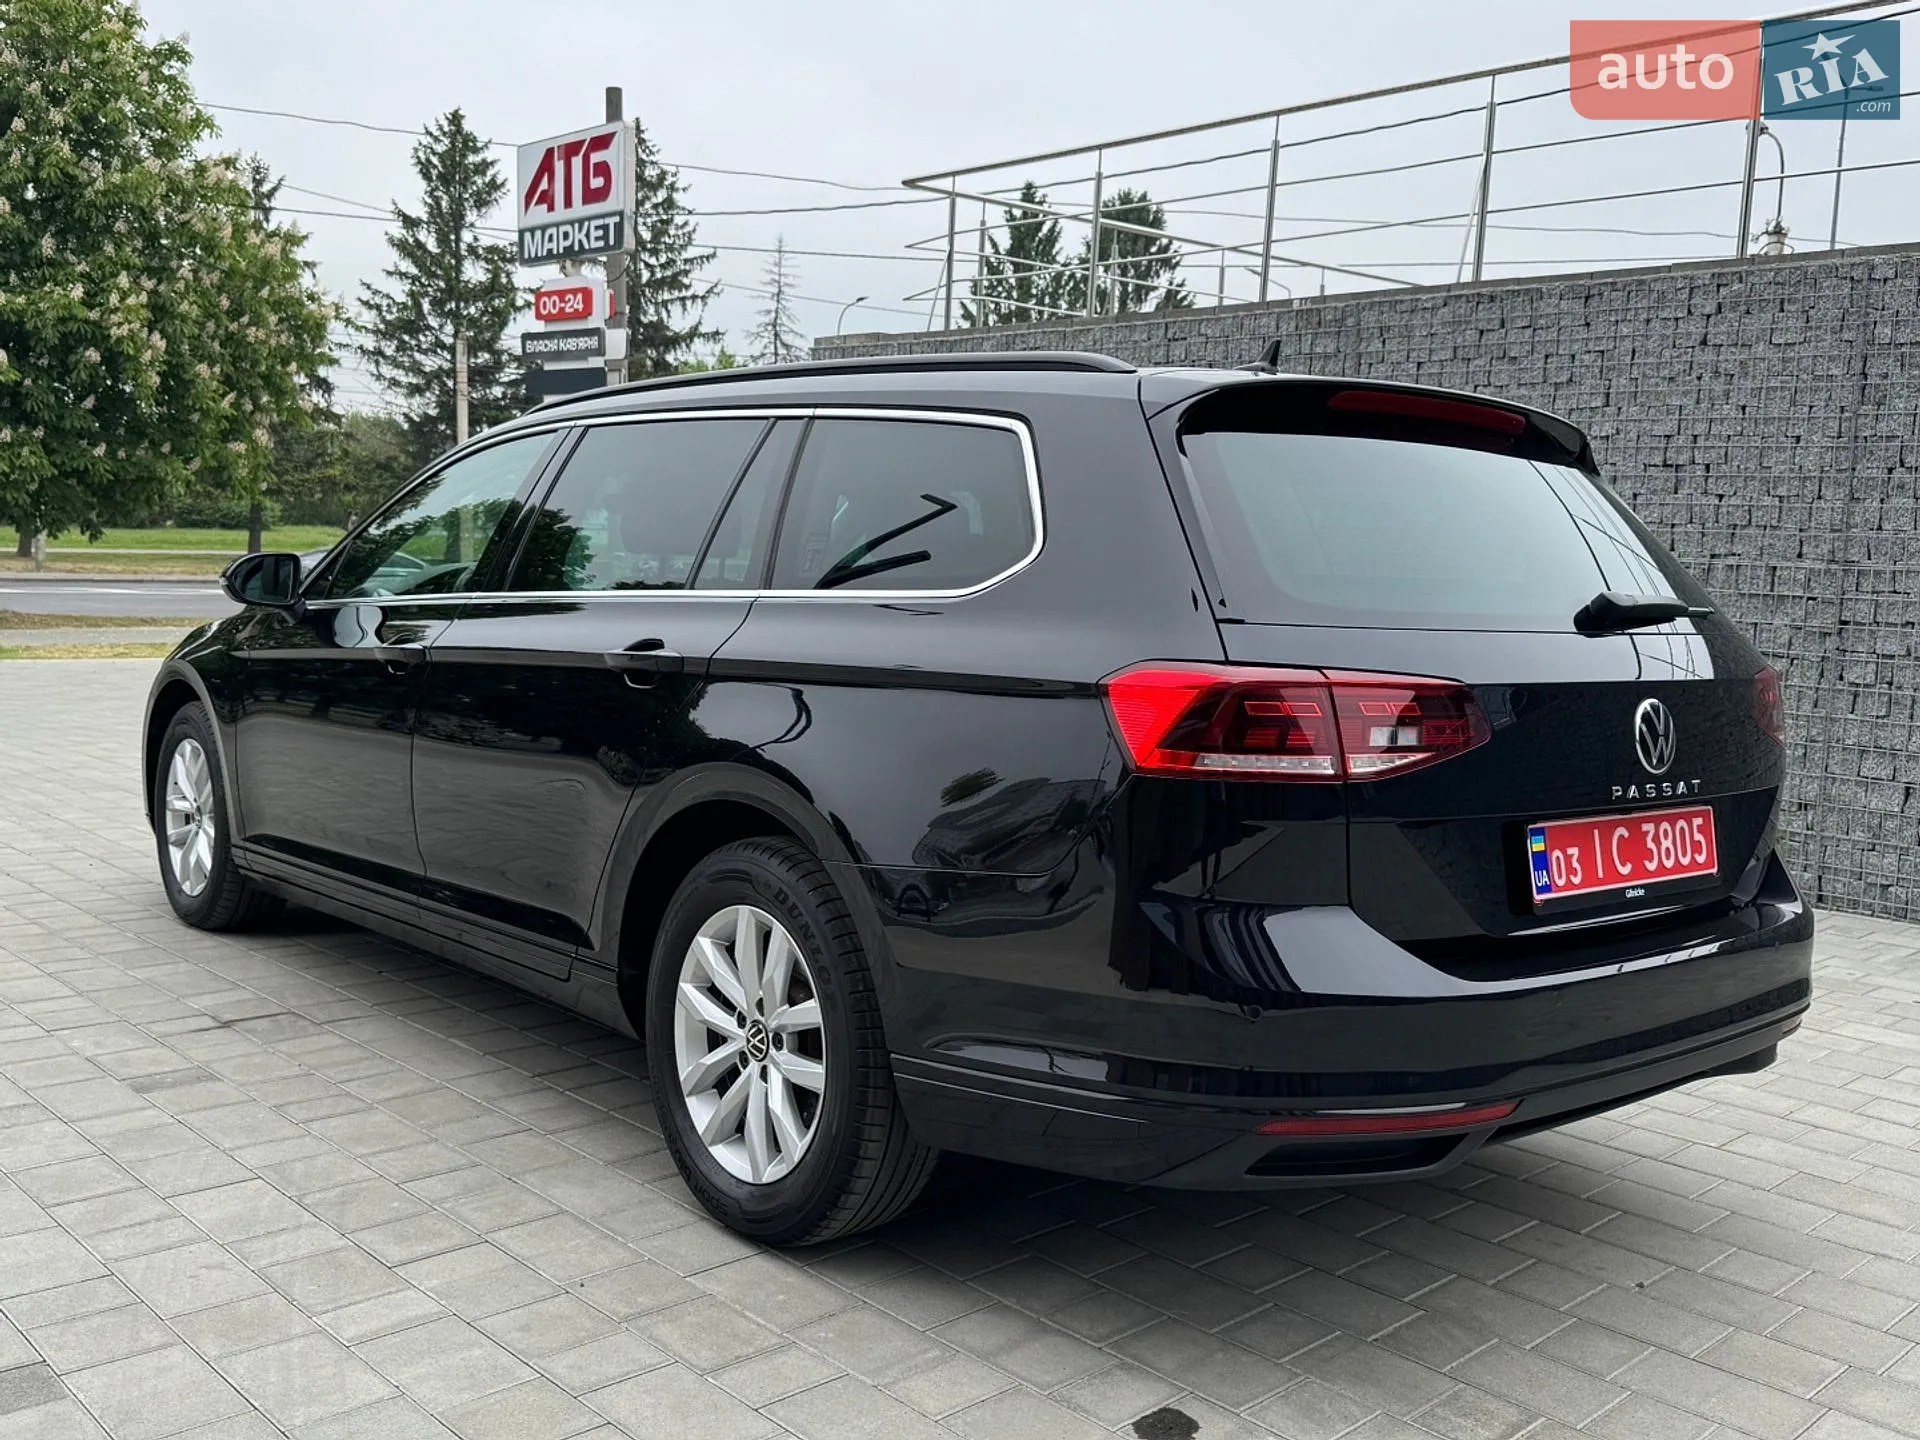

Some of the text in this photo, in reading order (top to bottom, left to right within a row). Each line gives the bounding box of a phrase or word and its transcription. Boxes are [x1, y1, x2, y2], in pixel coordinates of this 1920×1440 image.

[524, 131, 618, 217] АТБ
[523, 216, 620, 260] МАРКЕТ
[539, 293, 585, 315] 00-24
[1611, 779, 1702, 800] PASSAT
[1551, 817, 1708, 888] 03 IC 3805
[1534, 870, 1550, 887] UA
